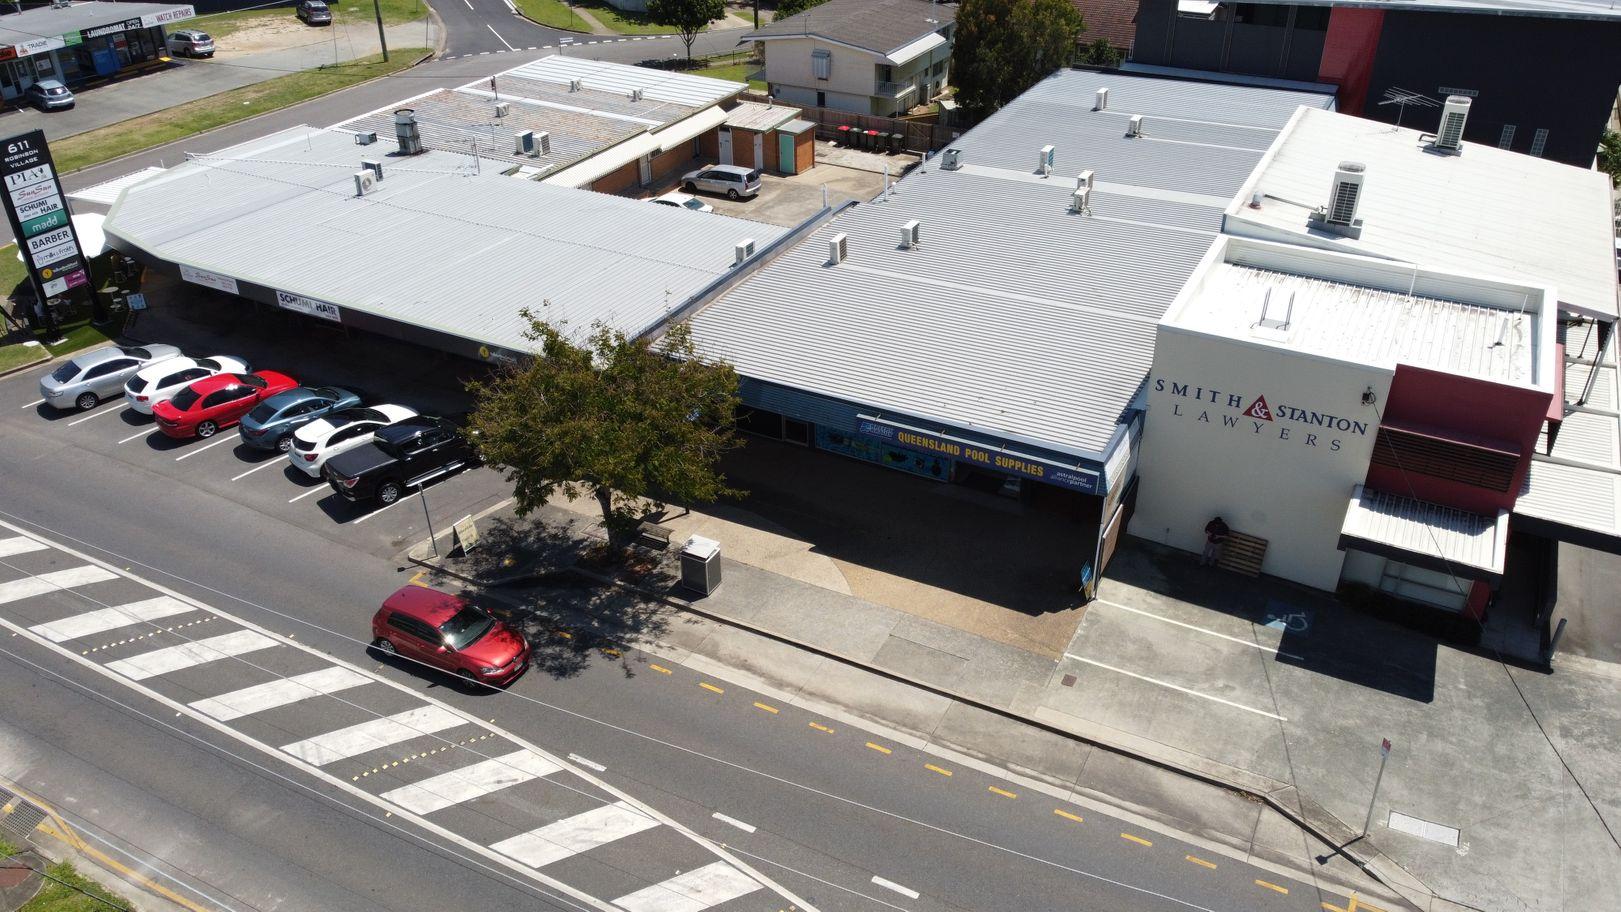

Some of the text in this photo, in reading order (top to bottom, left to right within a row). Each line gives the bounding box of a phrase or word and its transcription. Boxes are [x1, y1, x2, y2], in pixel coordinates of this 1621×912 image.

[87, 23, 126, 39] LAUNDROMAT
[8, 140, 30, 154] 611
[4, 149, 39, 162] ROBINSON
[10, 156, 39, 168] VILLAGE
[19, 199, 48, 214] SCHUMI
[40, 203, 59, 214] HAIR
[32, 215, 58, 233] madd
[31, 230, 70, 250] BARBER
[316, 303, 337, 316] HAIR
[1155, 378, 1369, 436] SMITH & STANTON
[1173, 404, 1341, 451] LAWYERS
[897, 431, 1044, 477] QUEENSLAND POOL SUPPLIES
